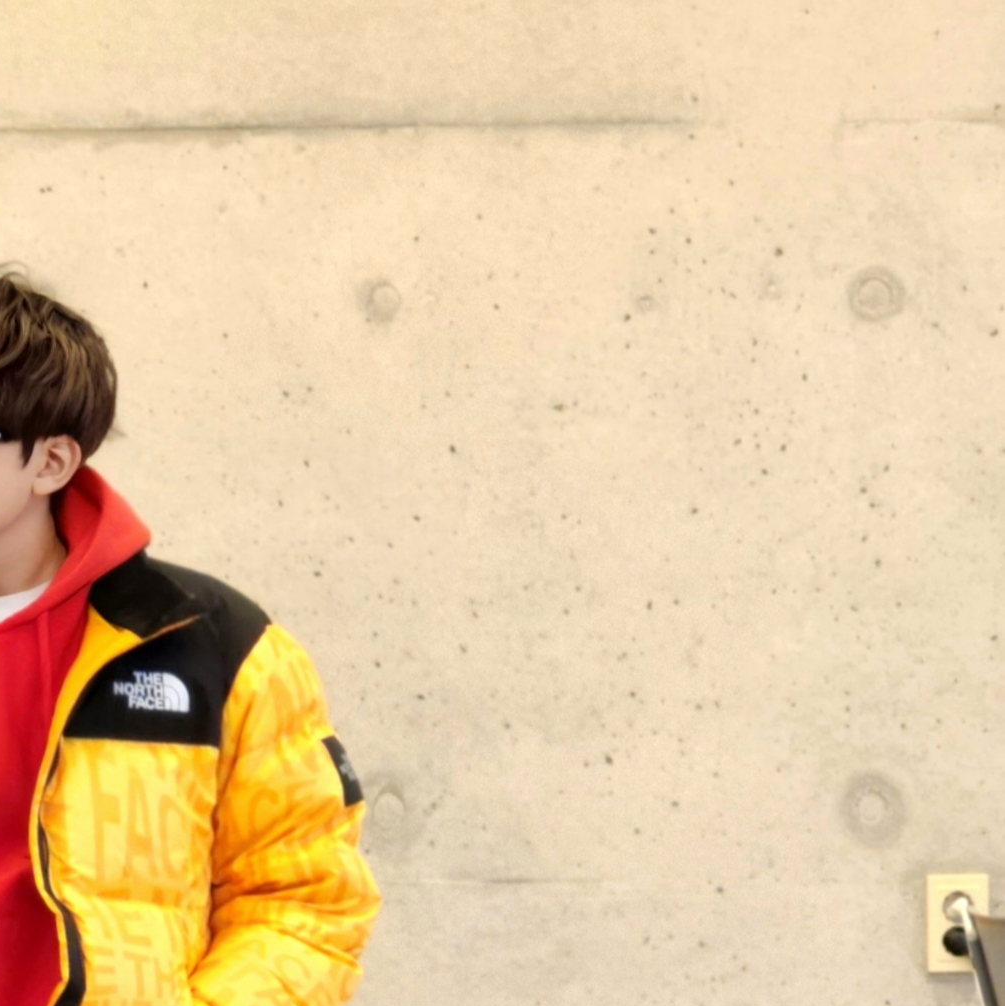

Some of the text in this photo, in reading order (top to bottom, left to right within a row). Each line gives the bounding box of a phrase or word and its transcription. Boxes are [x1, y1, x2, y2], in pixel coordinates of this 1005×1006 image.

[133, 671, 163, 684] THE
[113, 681, 163, 698] NORTH
[128, 696, 164, 710] FACE
